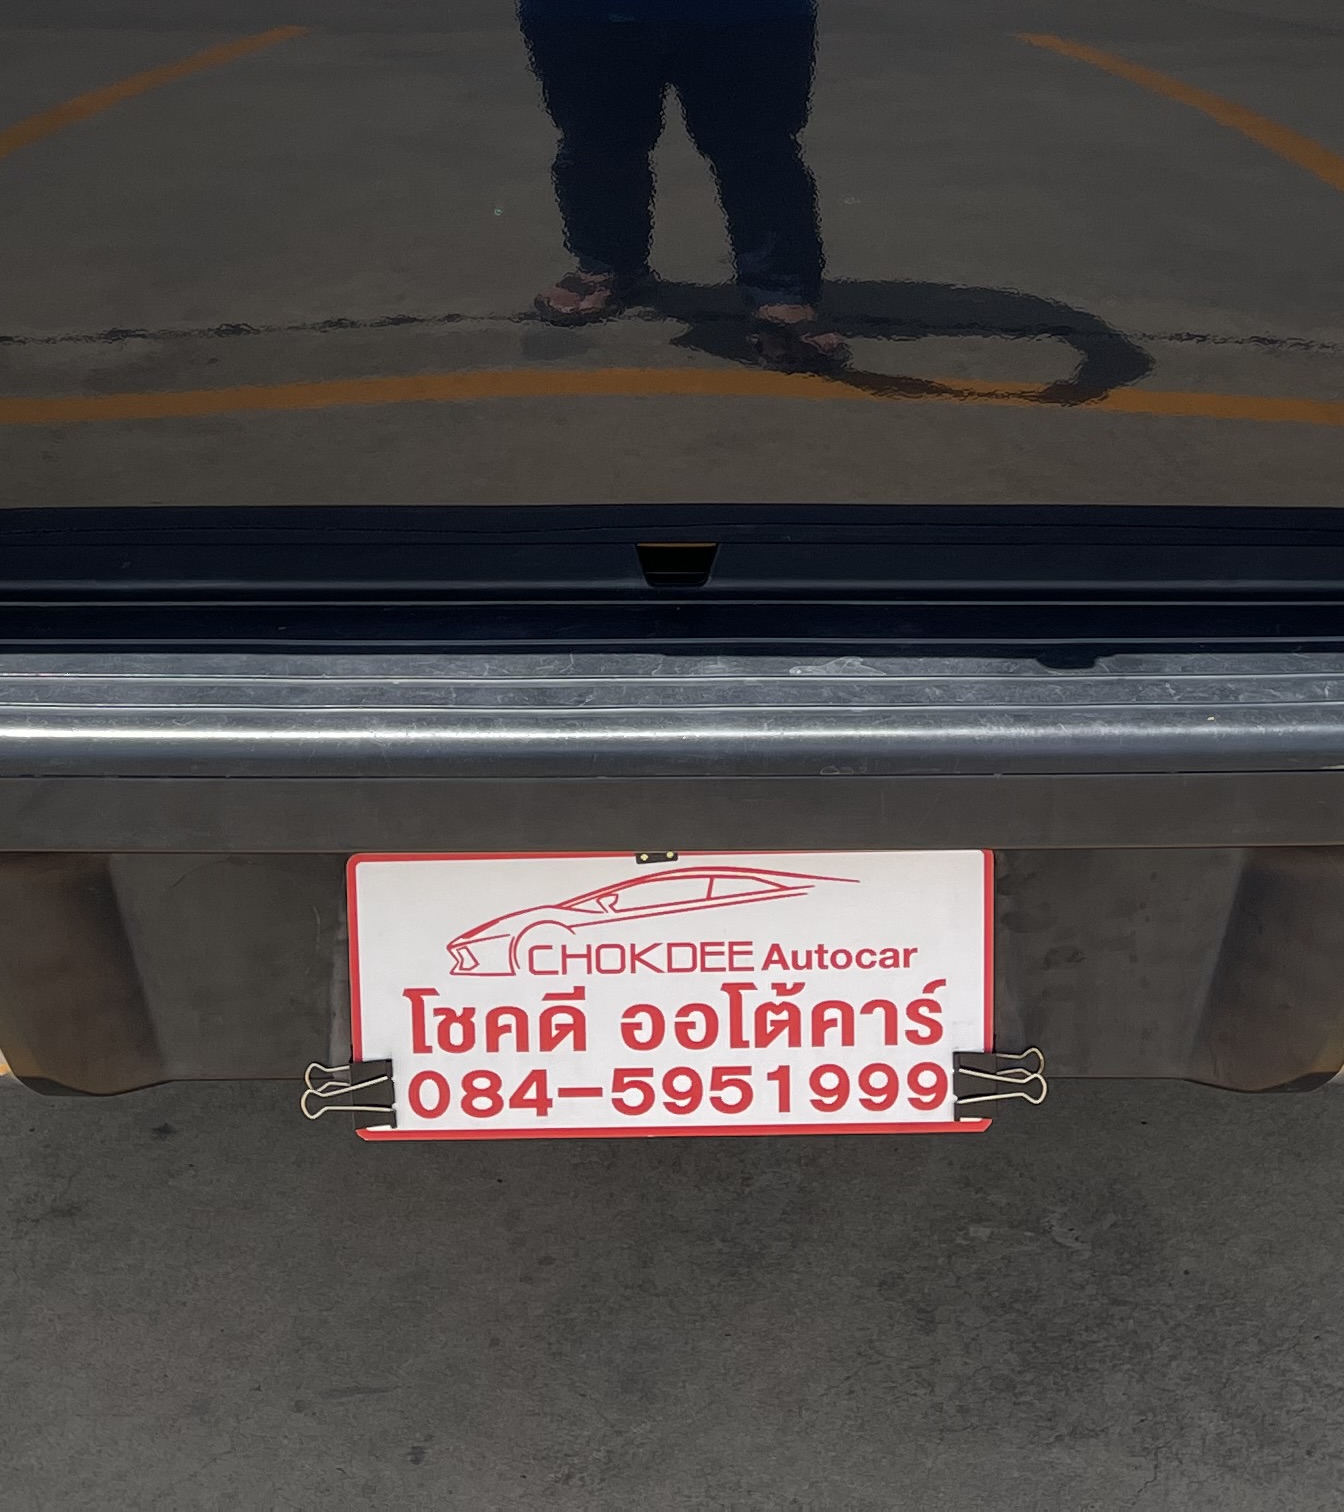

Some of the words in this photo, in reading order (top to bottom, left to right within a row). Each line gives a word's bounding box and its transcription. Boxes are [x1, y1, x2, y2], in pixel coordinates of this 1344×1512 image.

[528, 940, 755, 976] CHOKDEE
[762, 943, 918, 971] Autocar
[402, 985, 587, 1055] โชคดี
[620, 978, 947, 1052] ออโต้คาร์
[407, 1061, 950, 1120] 084-5951999
